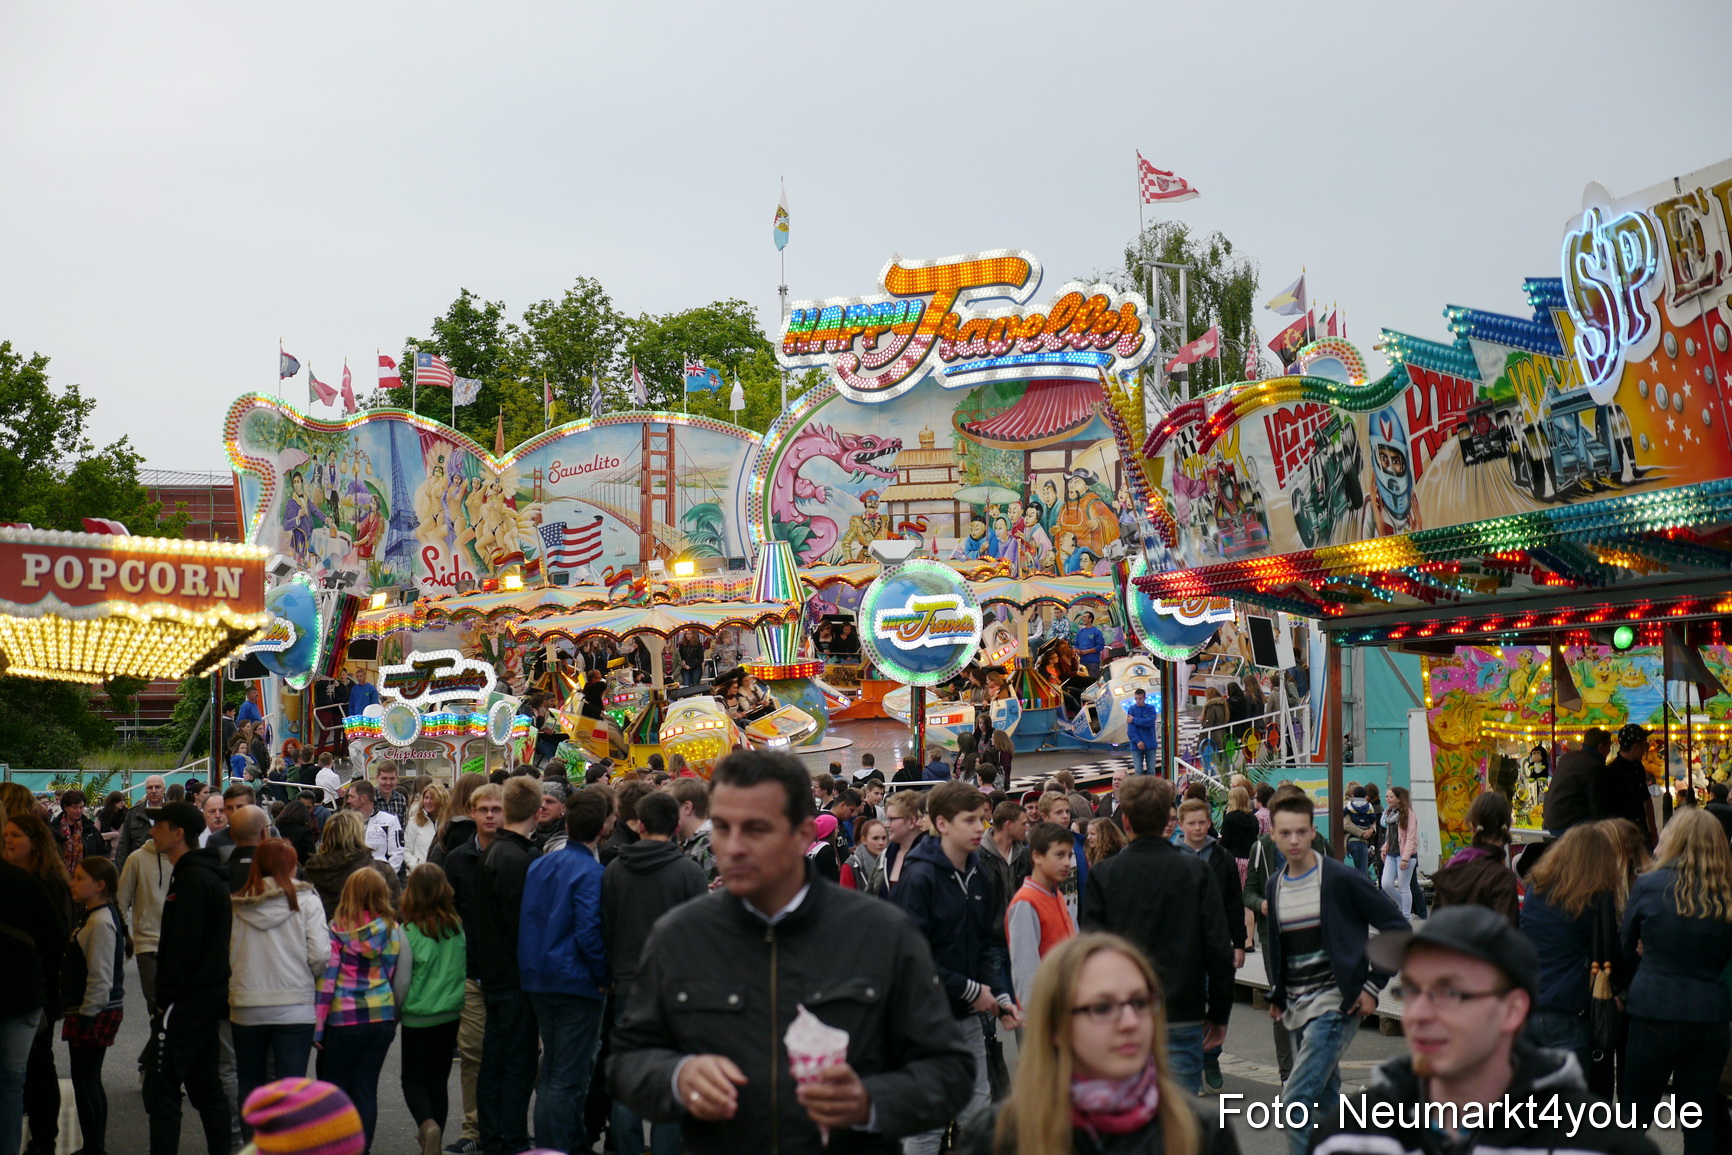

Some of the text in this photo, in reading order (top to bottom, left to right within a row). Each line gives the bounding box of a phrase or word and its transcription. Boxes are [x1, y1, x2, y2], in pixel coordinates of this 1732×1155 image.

[782, 257, 1145, 389] HAPPY Traveller
[548, 454, 620, 484] Sausalito
[21, 552, 244, 599] POPCORN
[383, 747, 438, 764] Chipkasse
